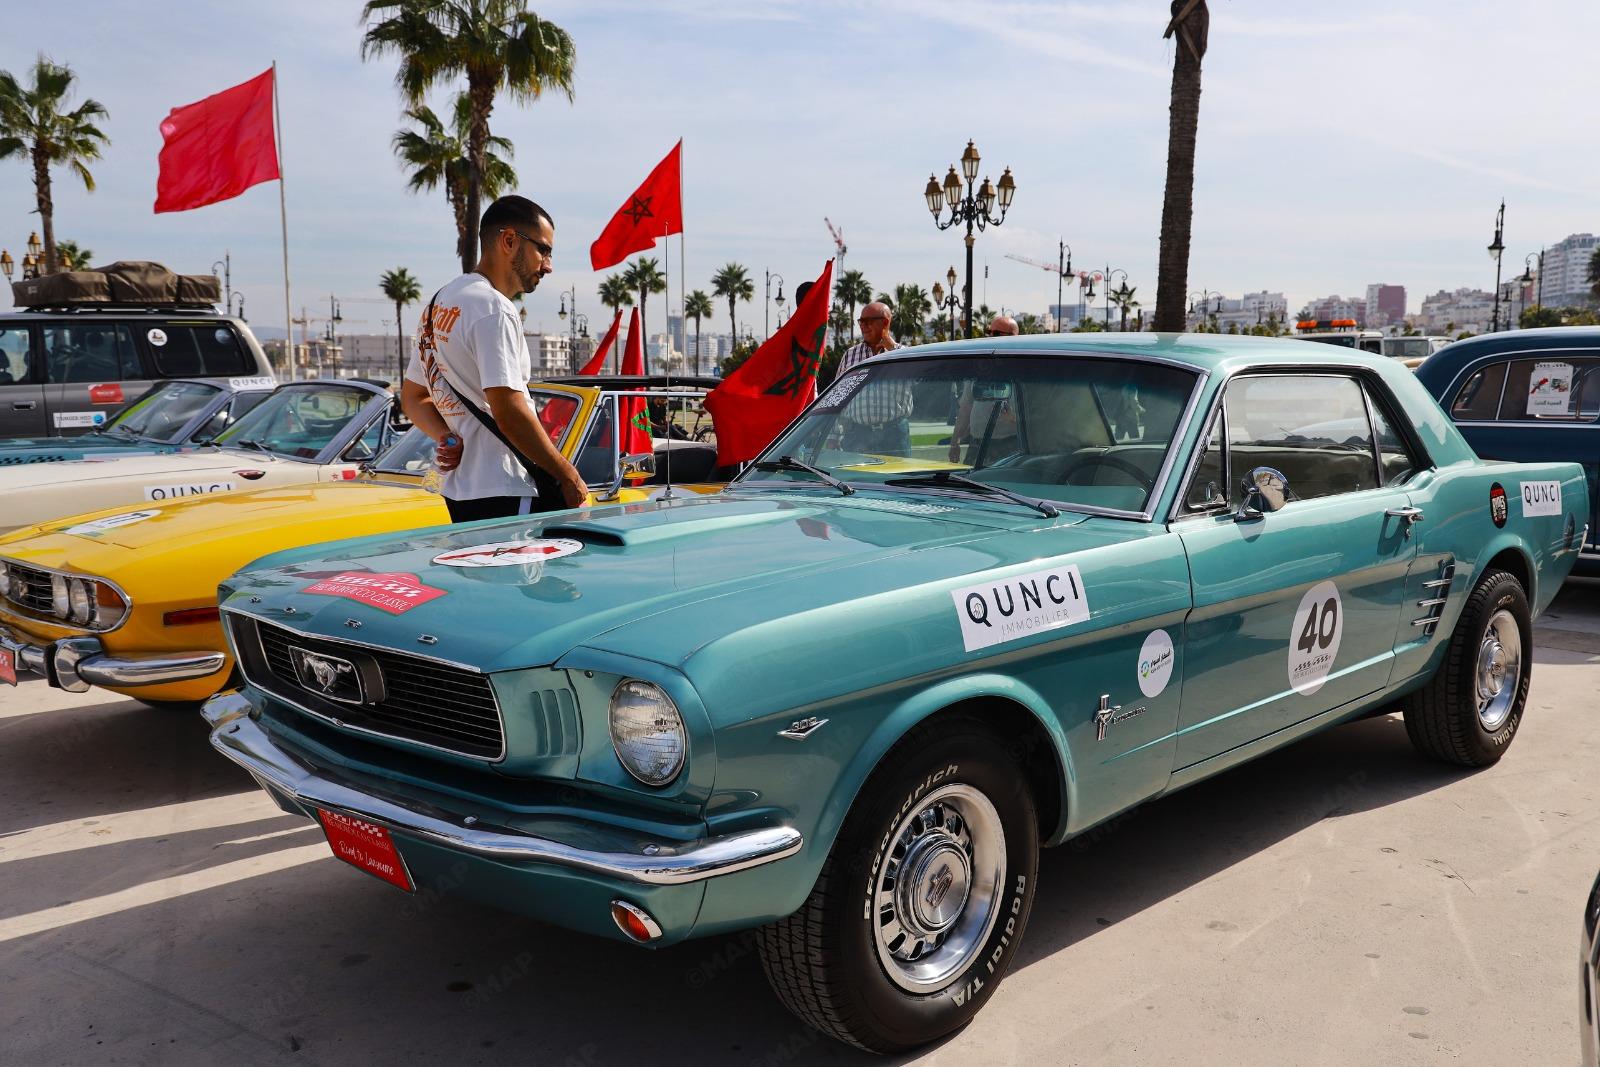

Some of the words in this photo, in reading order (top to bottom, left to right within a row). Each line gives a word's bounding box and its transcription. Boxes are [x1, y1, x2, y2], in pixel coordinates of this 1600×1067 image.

[233, 379, 271, 387] QUNCI
[1524, 484, 1560, 506] QUNCI
[965, 571, 1079, 627] QUNCI
[1001, 608, 1070, 635] IMMOBILIER
[1297, 597, 1338, 654] 40
[1492, 713, 1519, 746] RADIAL
[986, 874, 1026, 975] Radial
[951, 976, 1004, 1008] T/A
